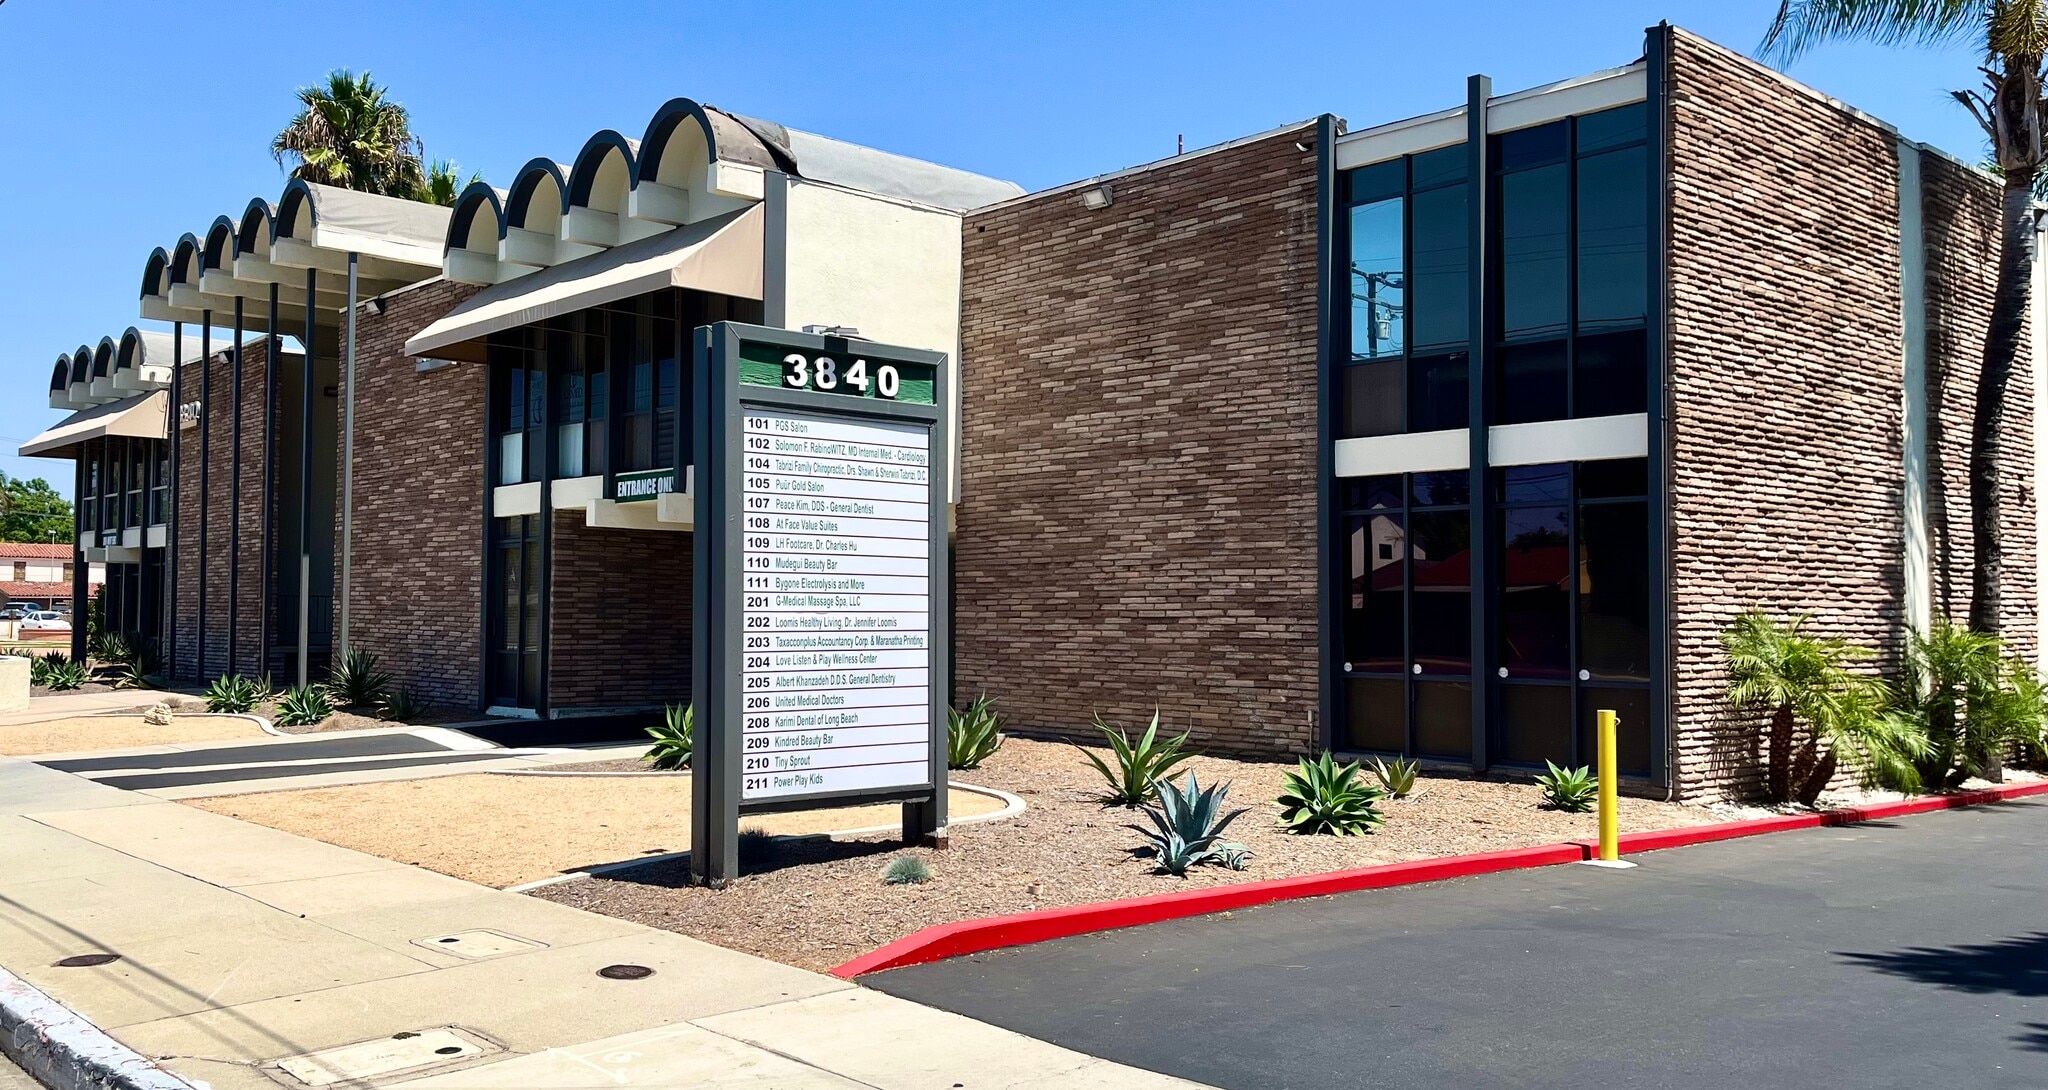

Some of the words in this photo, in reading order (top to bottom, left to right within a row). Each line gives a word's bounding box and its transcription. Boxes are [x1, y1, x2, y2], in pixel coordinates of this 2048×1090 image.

[783, 354, 900, 398] 3840
[747, 417, 769, 430] 101
[775, 419, 789, 432] PGS
[790, 421, 808, 433] Salon
[747, 437, 770, 450] 102
[775, 439, 803, 452] Solomon
[804, 441, 809, 452] F.
[848, 445, 858, 456] MD
[858, 446, 879, 458] Internal
[897, 450, 926, 464] Cardiology
[747, 457, 770, 469] 104
[775, 459, 794, 471] Tabrizi
[794, 461, 812, 474] Family
[813, 462, 846, 476] Chiropractic,
[846, 464, 857, 476] Drs.
[857, 465, 875, 477] Shawn
[875, 467, 879, 477] &
[617, 477, 657, 498] ENTRANCE
[747, 477, 770, 489] 105
[791, 480, 806, 491] Gold
[807, 480, 825, 493] Salon
[747, 497, 770, 509] 107
[775, 499, 795, 510] Peace
[796, 500, 810, 512] Kim,
[811, 501, 825, 512] DDS
[829, 502, 853, 513] General
[853, 503, 874, 514] Dentist
[747, 517, 770, 528] 108
[776, 519, 784, 529] At
[784, 519, 800, 530] Face
[801, 519, 818, 531] Value
[819, 520, 838, 532] Suites
[747, 537, 770, 548] 109
[775, 538, 784, 549] LH
[785, 538, 815, 551] Footcare,
[815, 539, 824, 550] Dr.
[825, 539, 848, 551] Charles
[848, 540, 858, 551] Hu
[747, 557, 770, 568] 110
[775, 558, 803, 572] Mudegui
[804, 558, 826, 572] Beauty
[826, 559, 838, 570] Bar
[747, 577, 769, 588] 111
[775, 578, 800, 591] Bygone
[801, 578, 837, 591] Electrolysis
[837, 579, 850, 590] and
[850, 579, 865, 590] More
[747, 597, 769, 608] 201
[775, 595, 807, 607] G-Medical
[807, 595, 834, 608] Massage
[835, 596, 848, 608] Spa,
[849, 596, 861, 606] LLC
[747, 617, 770, 628] 202
[775, 617, 799, 628] Loomis
[799, 617, 823, 630] Healthy
[823, 616, 842, 630] Living,
[844, 617, 853, 627] Dr.
[853, 616, 877, 627] Jennifer
[877, 616, 897, 627] Loomis
[747, 637, 770, 648] 203
[817, 636, 854, 648] Accountancy
[870, 636, 875, 646] &
[875, 635, 903, 646] Maranatha
[903, 634, 923, 647] Printing
[747, 657, 770, 668] 204
[775, 655, 791, 666] Love
[792, 654, 812, 666] Listen
[812, 654, 817, 665] &
[818, 654, 832, 667] Play
[832, 654, 859, 664] Wellness
[859, 653, 878, 664] Center
[747, 677, 770, 688] 205
[775, 676, 795, 687] Albert
[796, 675, 829, 687] Khanzadeh
[830, 674, 848, 685] D.D.S.
[848, 674, 871, 685] General
[871, 673, 896, 685] Dentistry
[747, 697, 770, 708] 206
[775, 696, 796, 707] United
[796, 695, 820, 707] Medical
[821, 695, 845, 706] Doctors
[747, 717, 770, 729] 208
[774, 715, 795, 728] Karimi
[796, 715, 816, 727] Dental
[817, 714, 824, 725] of
[824, 714, 840, 727] Long
[840, 713, 859, 724] Beach
[747, 738, 770, 749] 209
[774, 735, 800, 748] Kindred
[800, 735, 822, 747] Beauty
[823, 734, 834, 745] Bar
[746, 758, 769, 769] 210
[774, 756, 789, 770] Tiny
[789, 755, 810, 768] Sprout
[746, 778, 768, 790] 211
[774, 776, 794, 788] Power
[794, 775, 809, 789] Play
[809, 774, 823, 785] Kids
